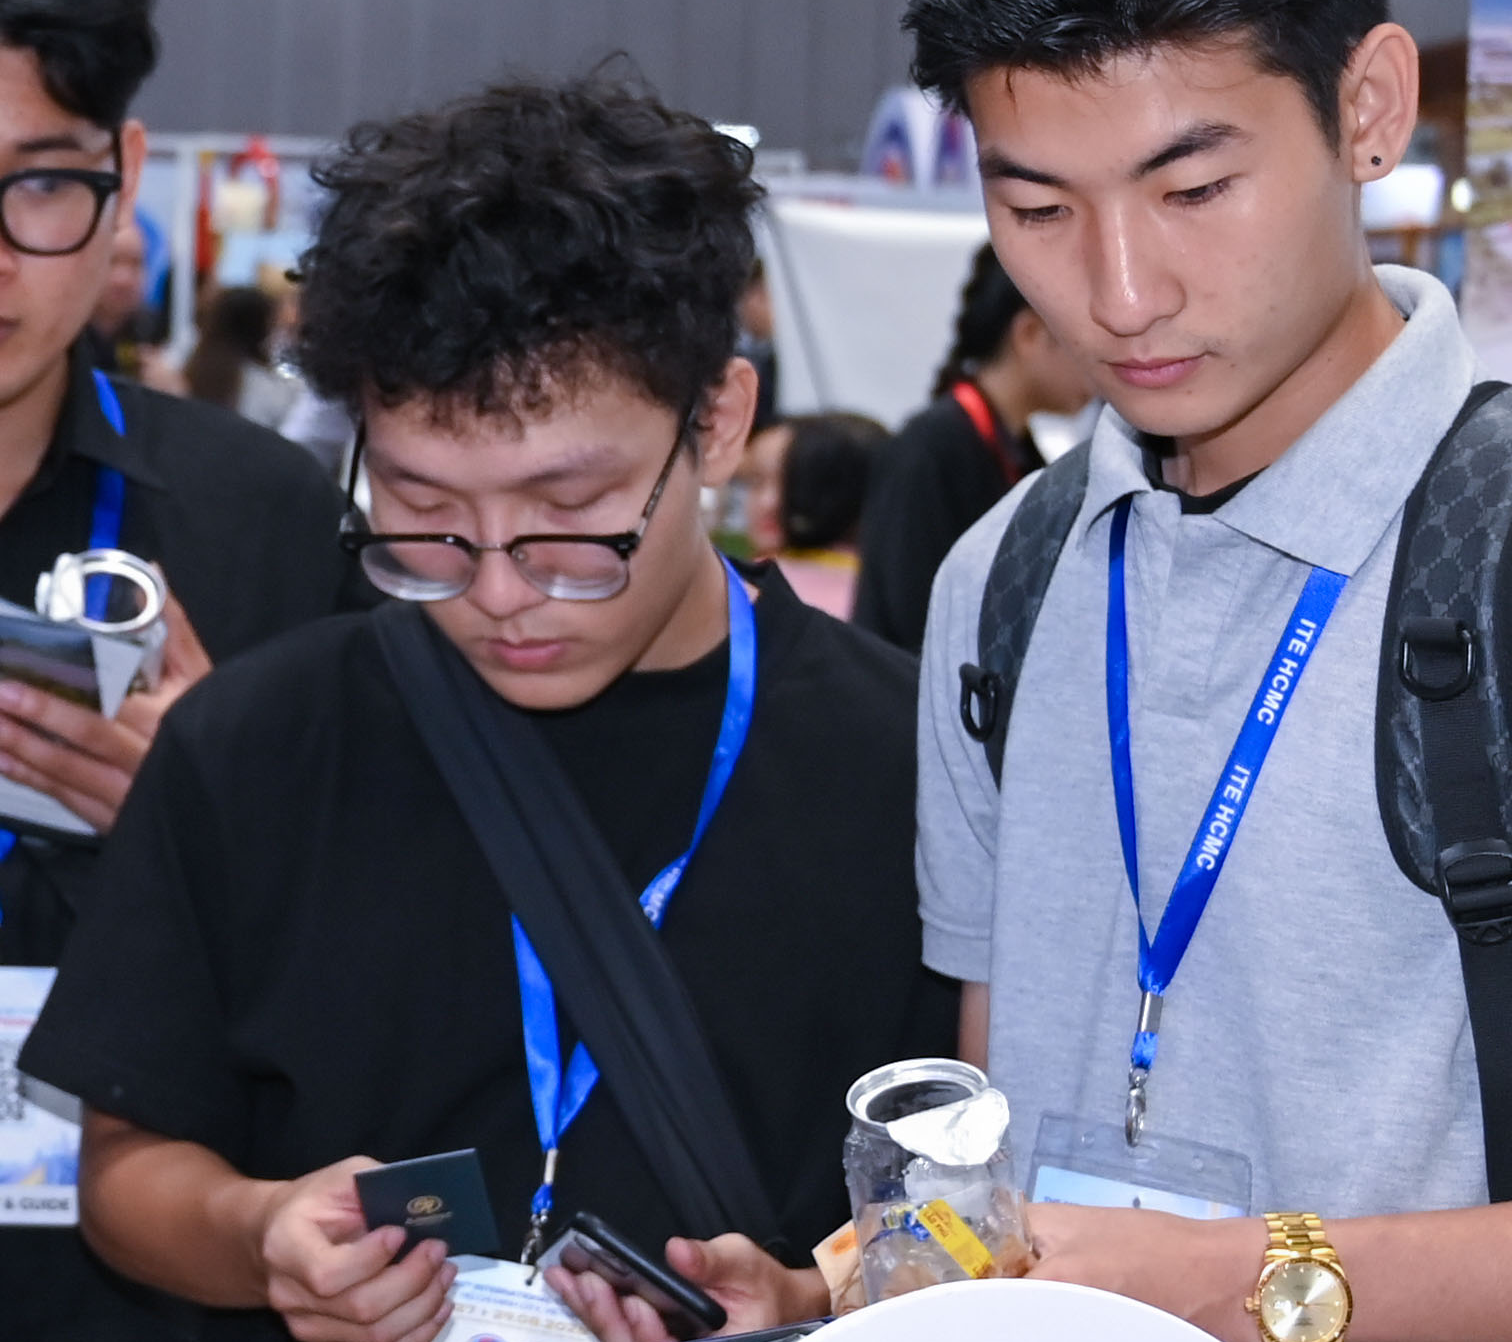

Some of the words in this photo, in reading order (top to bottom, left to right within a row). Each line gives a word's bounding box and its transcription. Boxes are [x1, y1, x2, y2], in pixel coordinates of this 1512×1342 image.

[1288, 617, 1318, 657] ITE
[1257, 658, 1299, 725] HCMC
[1223, 763, 1251, 804] ITE
[1196, 804, 1235, 871] HCMC
[19, 1196, 70, 1210] GUIDE
